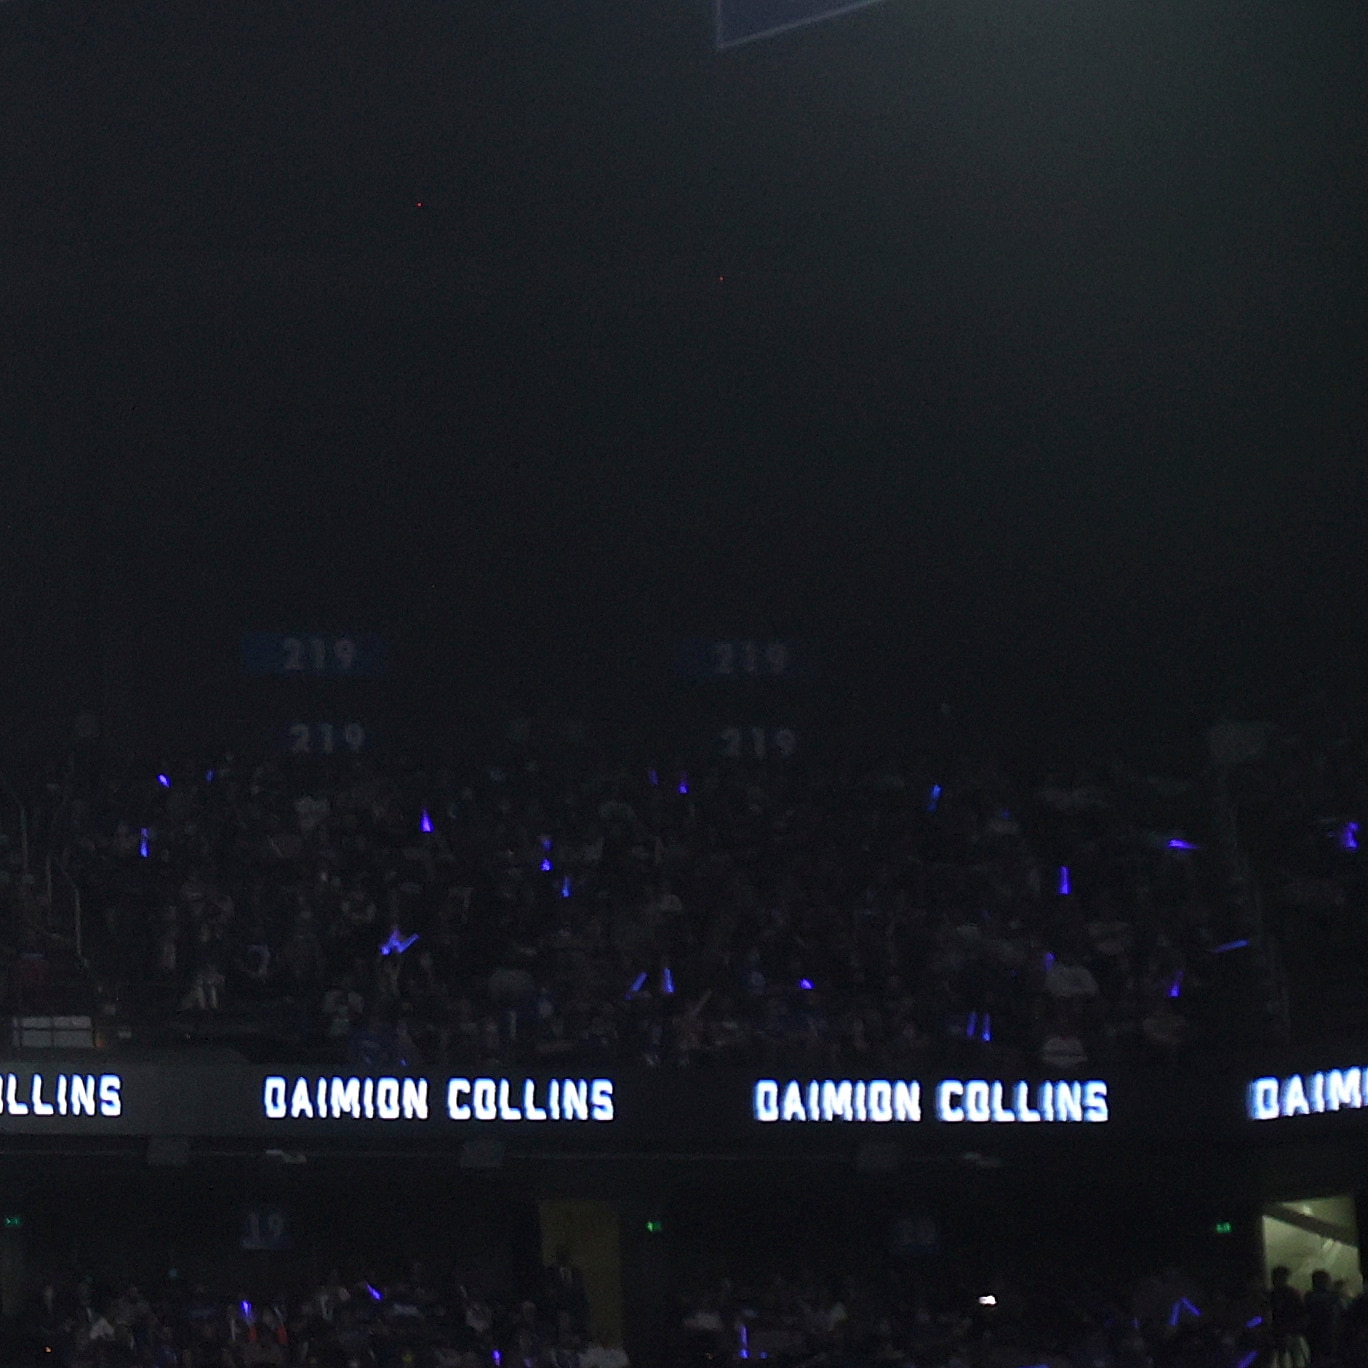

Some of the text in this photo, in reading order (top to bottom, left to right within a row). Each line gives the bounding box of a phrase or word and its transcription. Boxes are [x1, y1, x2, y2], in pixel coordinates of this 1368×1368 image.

[282, 637, 357, 671] 219
[264, 1076, 614, 1121] DAIMION COLLINS
[753, 1079, 1110, 1122] DAIMION COLLINS
[1251, 1065, 1368, 1121] DAIM
